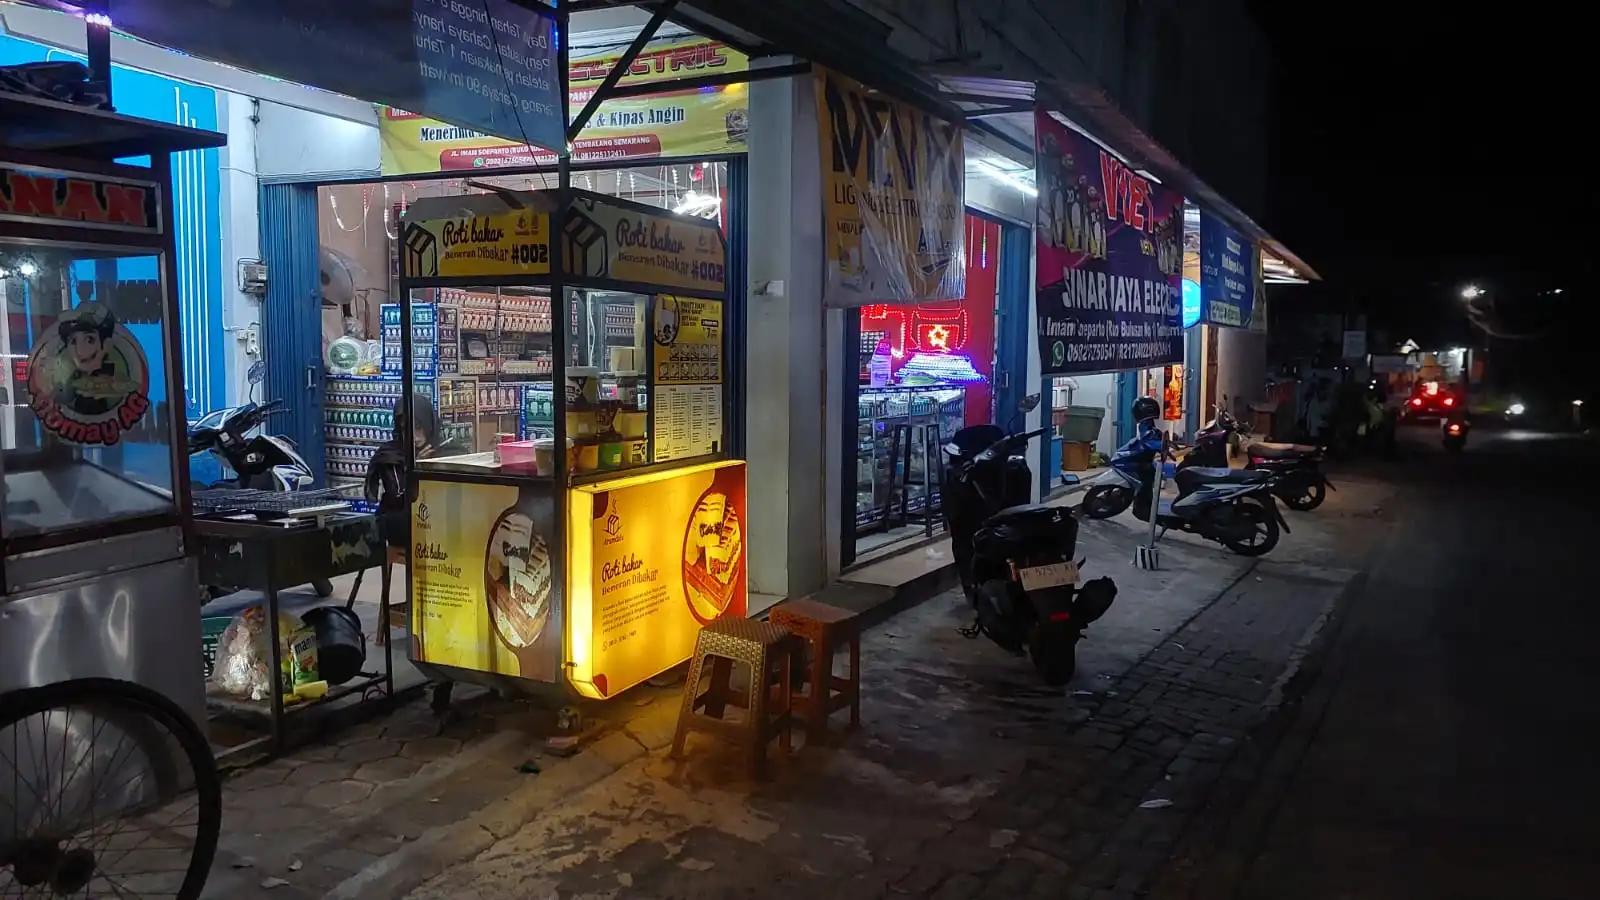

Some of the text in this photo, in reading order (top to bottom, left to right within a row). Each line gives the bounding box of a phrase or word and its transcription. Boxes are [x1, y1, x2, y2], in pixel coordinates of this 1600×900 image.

[596, 112, 606, 128] &
[610, 110, 645, 128] Kipas
[647, 106, 685, 126] Angin
[575, 136, 651, 149] TEMBALANG SEMARANG
[442, 215, 505, 248] Roti bakar
[616, 217, 686, 255] Roti bakar
[444, 243, 548, 265] Beneran Dibakar #002
[617, 250, 724, 283] Beneran Dibakar #002
[1062, 265, 1108, 312] SINAR
[1109, 274, 1142, 313] JAYA
[1046, 315, 1075, 338] Imam
[601, 552, 644, 583] Roti bakar
[601, 568, 660, 597] Beneran Dibakar
